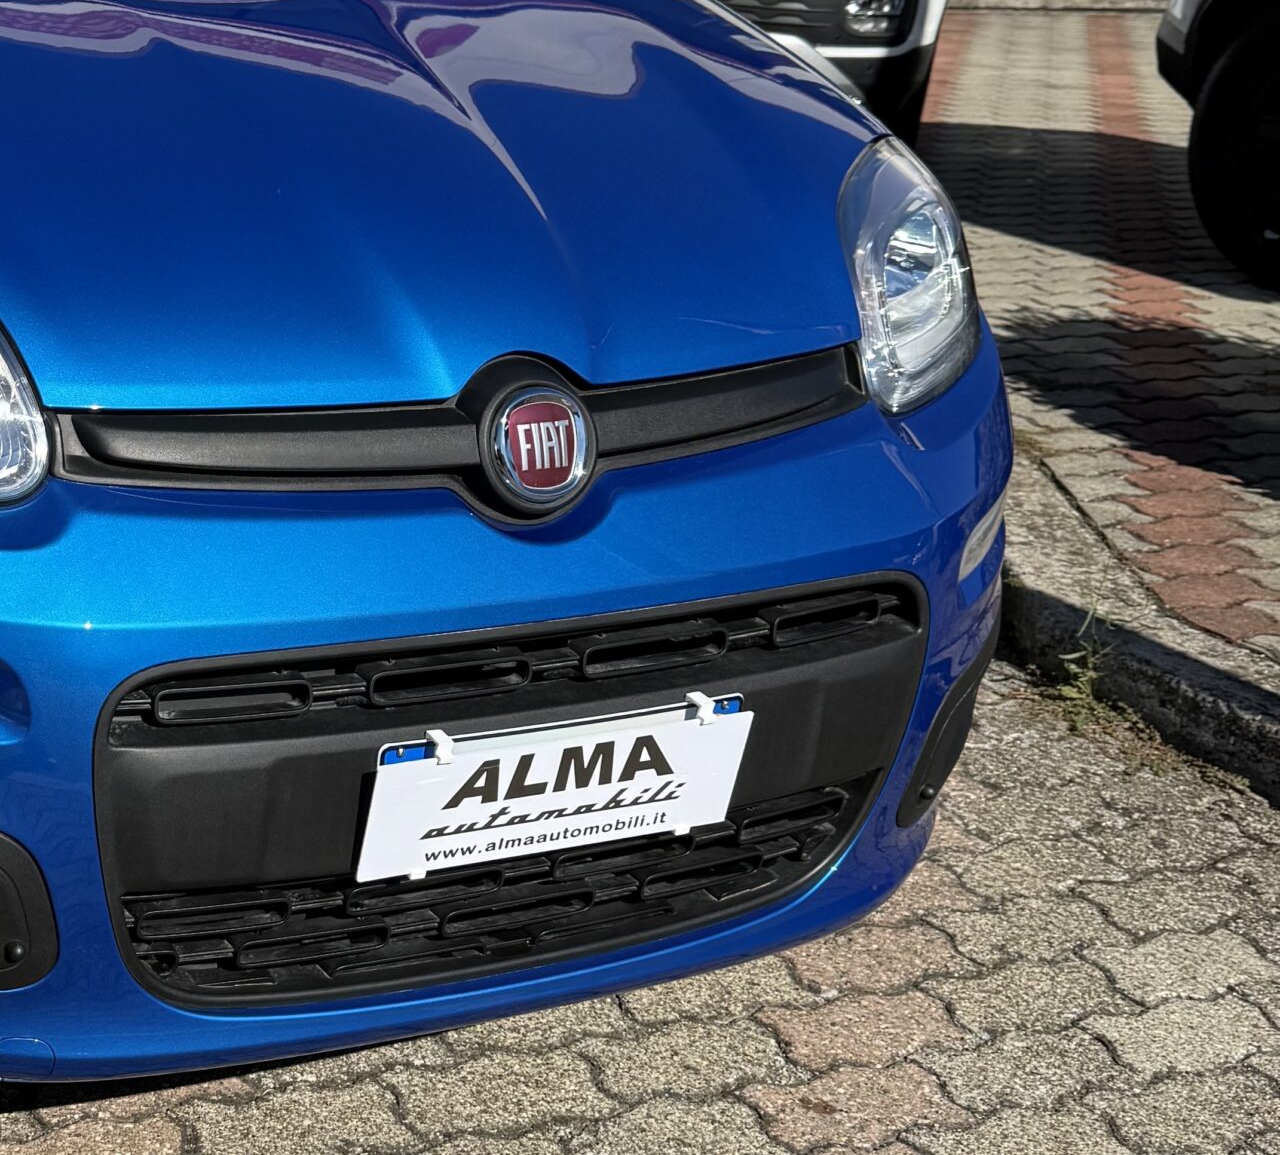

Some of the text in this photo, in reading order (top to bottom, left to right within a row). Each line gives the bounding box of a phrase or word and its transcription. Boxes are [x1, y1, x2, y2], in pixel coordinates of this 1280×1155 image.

[516, 419, 569, 472] FIAT
[441, 734, 674, 810] ALMA
[419, 781, 686, 840] automobili
[424, 810, 667, 863] www.almaautomobili.it
